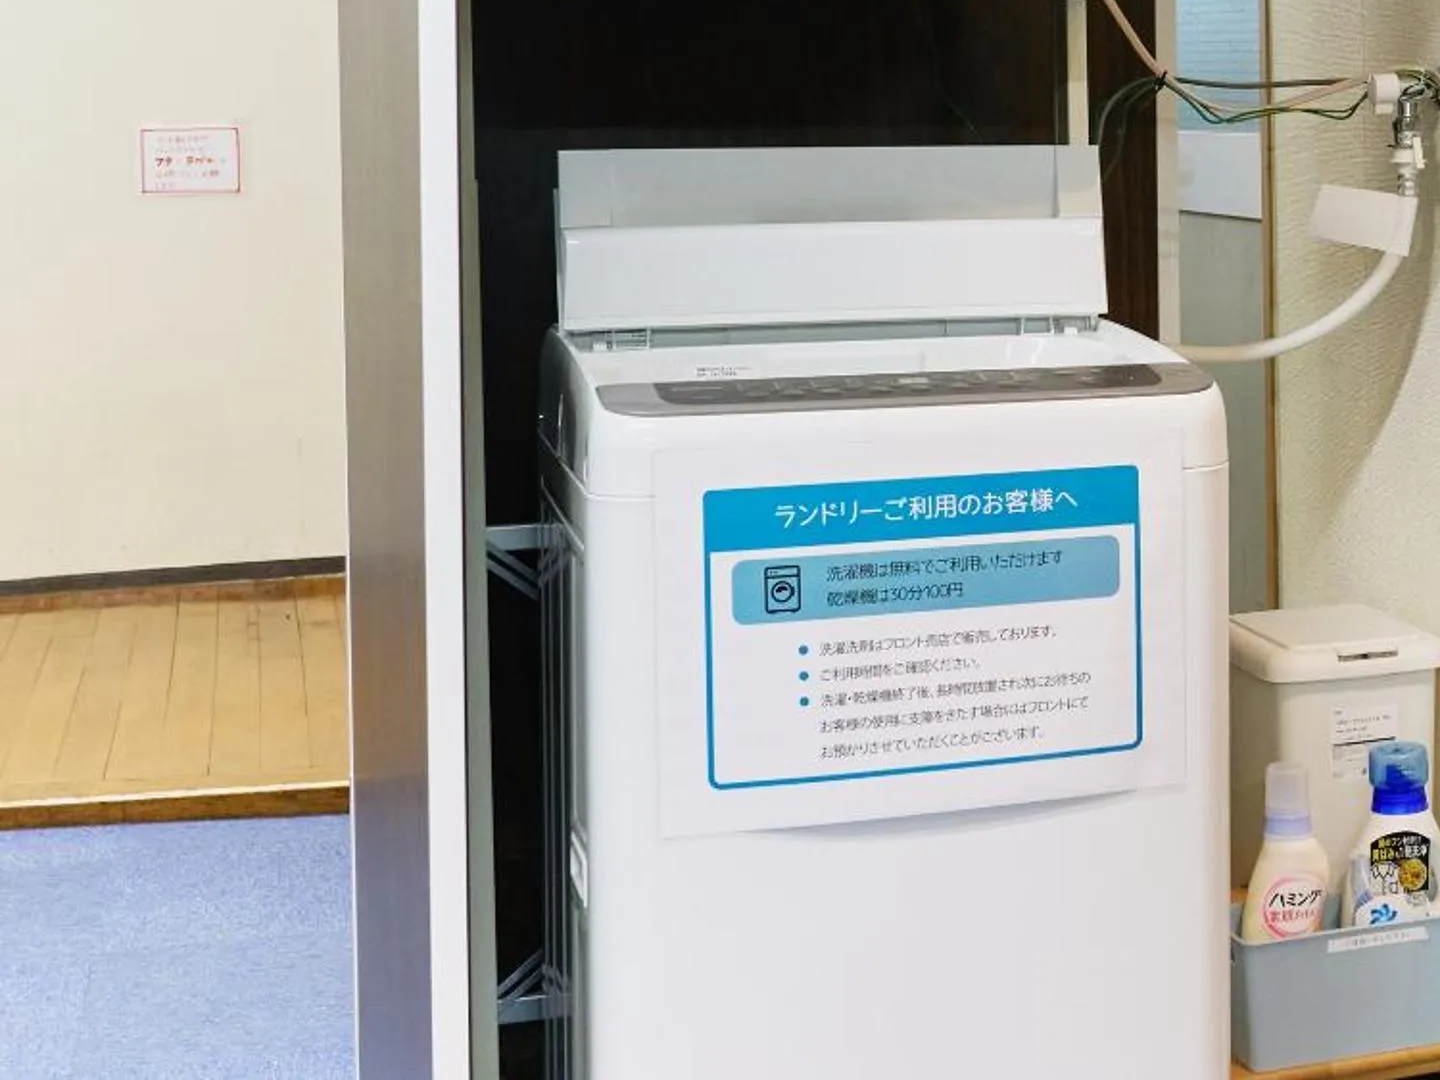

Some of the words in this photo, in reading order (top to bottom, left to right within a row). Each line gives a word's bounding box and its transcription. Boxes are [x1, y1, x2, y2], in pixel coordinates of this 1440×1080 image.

[774, 488, 1079, 529] ランドリーご利用のお客様へ
[826, 549, 1064, 582] 洗濯機は無料でご利用いただけます
[826, 582, 964, 607] 乾燥機は30分100円
[1269, 889, 1322, 908] ハミング
